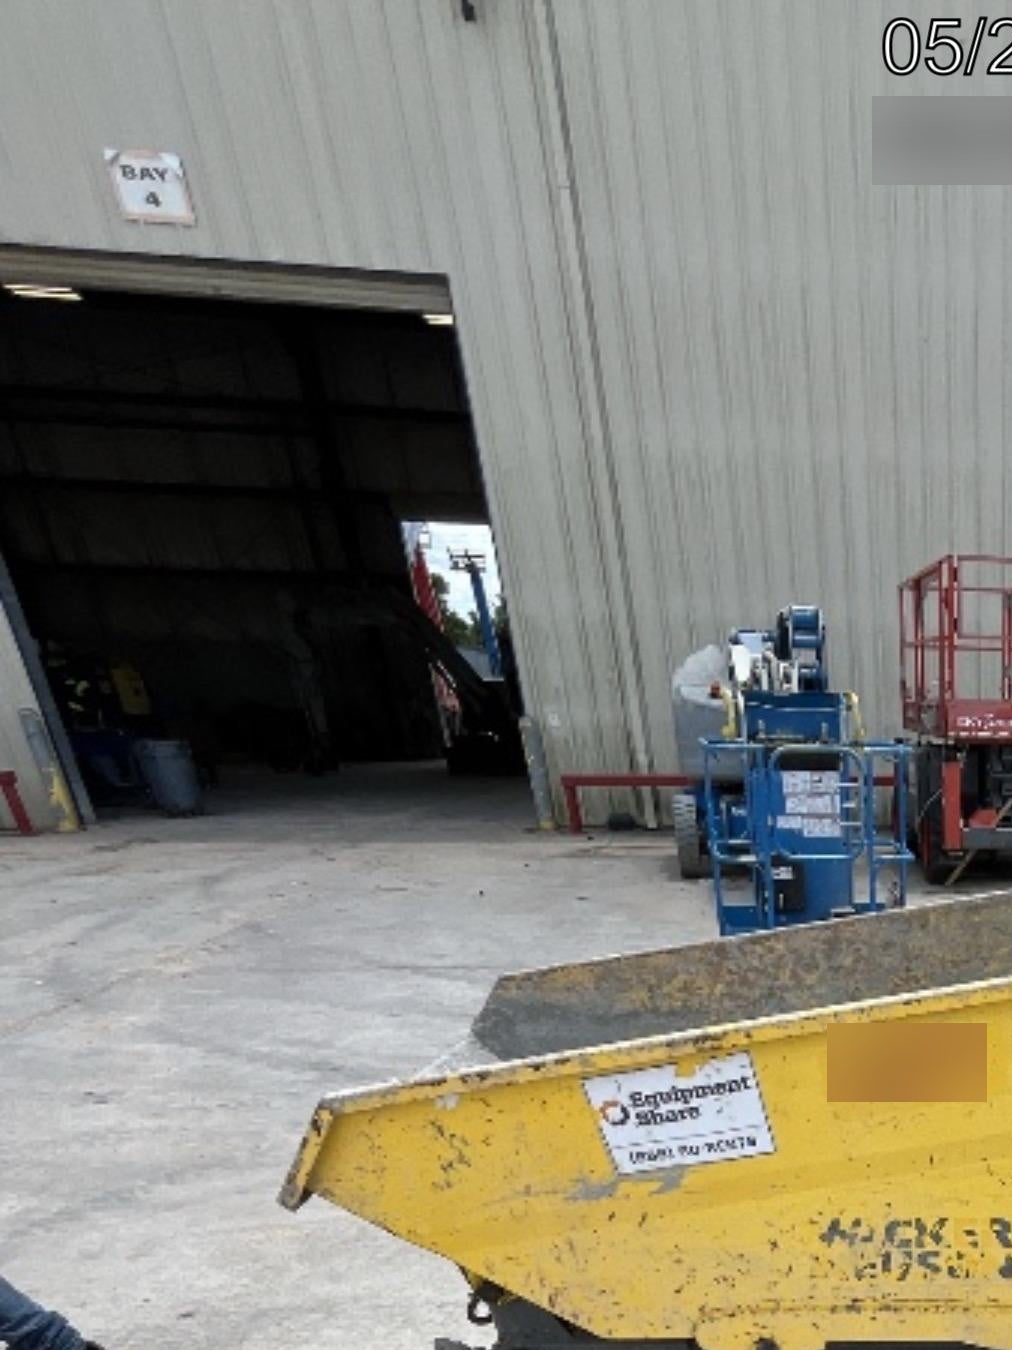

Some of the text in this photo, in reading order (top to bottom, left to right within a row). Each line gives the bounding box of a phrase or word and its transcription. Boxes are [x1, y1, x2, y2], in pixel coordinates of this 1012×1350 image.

[119, 164, 168, 182] BAY
[145, 191, 161, 208] 4
[629, 1076, 752, 1109] Equipment
[635, 1106, 701, 1127] Share
